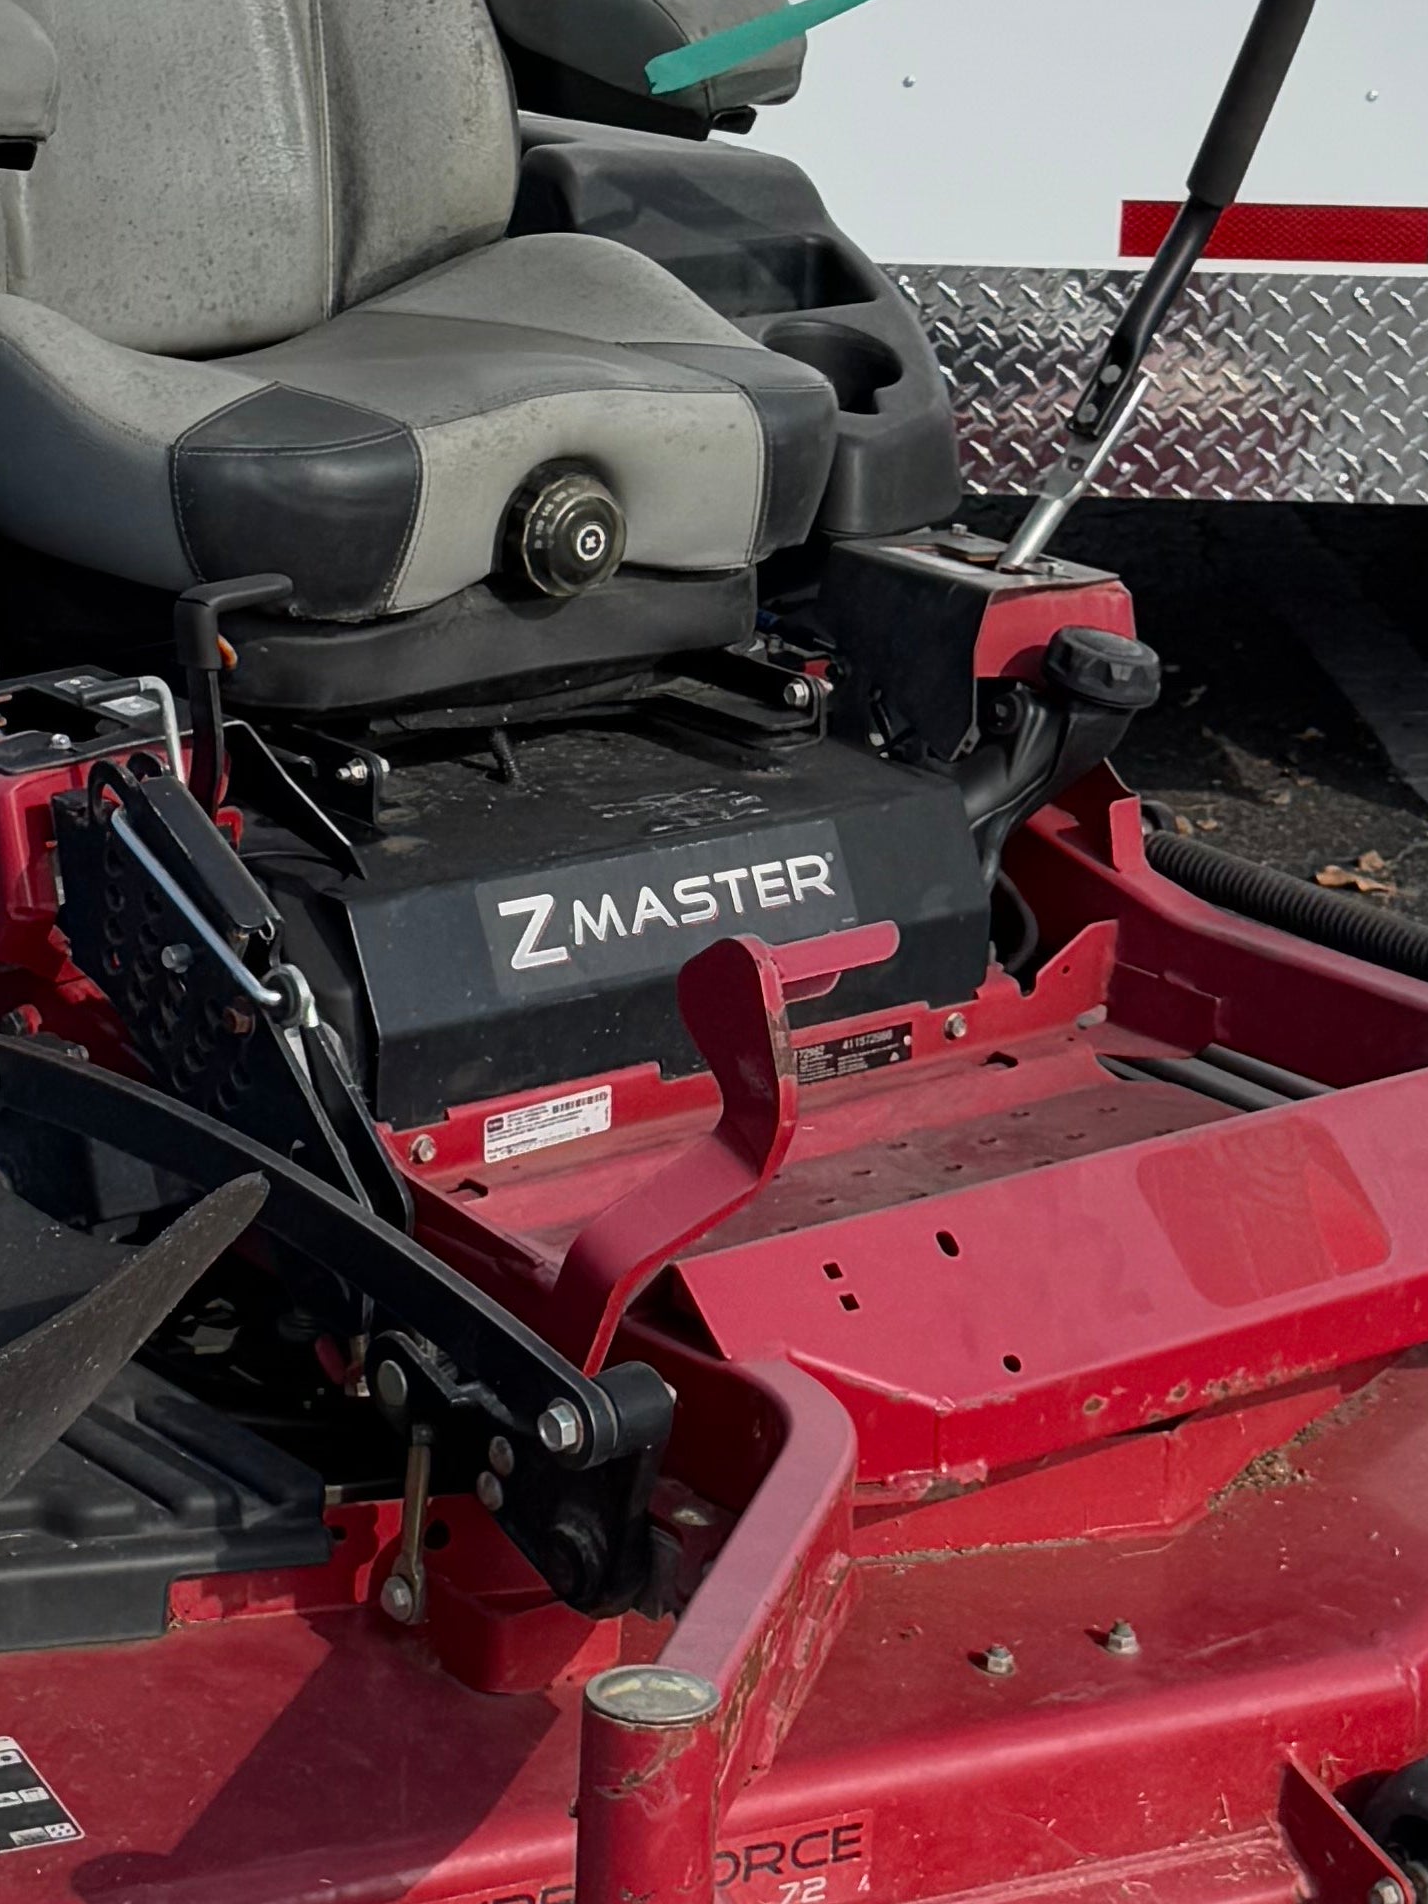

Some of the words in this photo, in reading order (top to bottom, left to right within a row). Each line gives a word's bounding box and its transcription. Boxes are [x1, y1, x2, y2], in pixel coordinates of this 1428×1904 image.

[498, 893, 570, 970] Z
[573, 854, 836, 946] MASTER
[713, 1822, 864, 1888] ORCE
